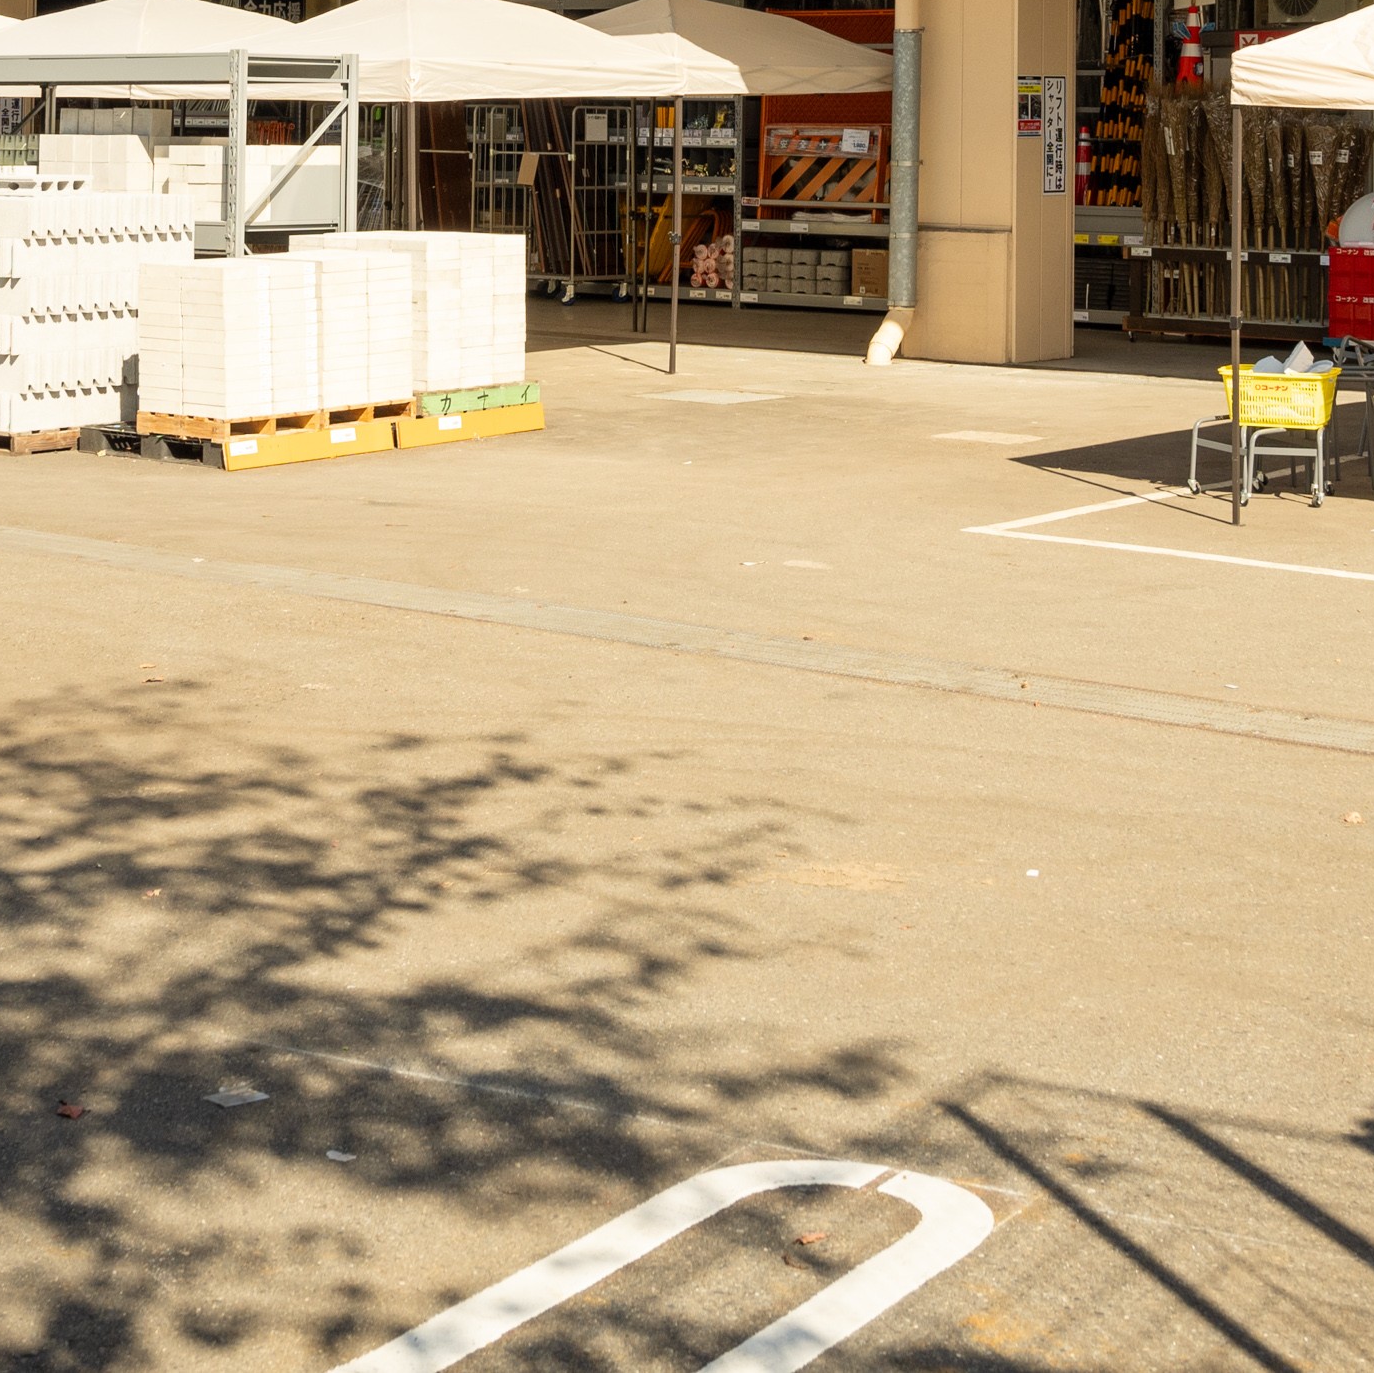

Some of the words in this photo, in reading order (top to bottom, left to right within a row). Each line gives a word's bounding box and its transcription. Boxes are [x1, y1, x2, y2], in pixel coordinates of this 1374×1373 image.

[1055, 80, 1064, 190] リフト運行時は
[1335, 295, 1358, 303] コーナン
[1262, 384, 1288, 392] コーナン
